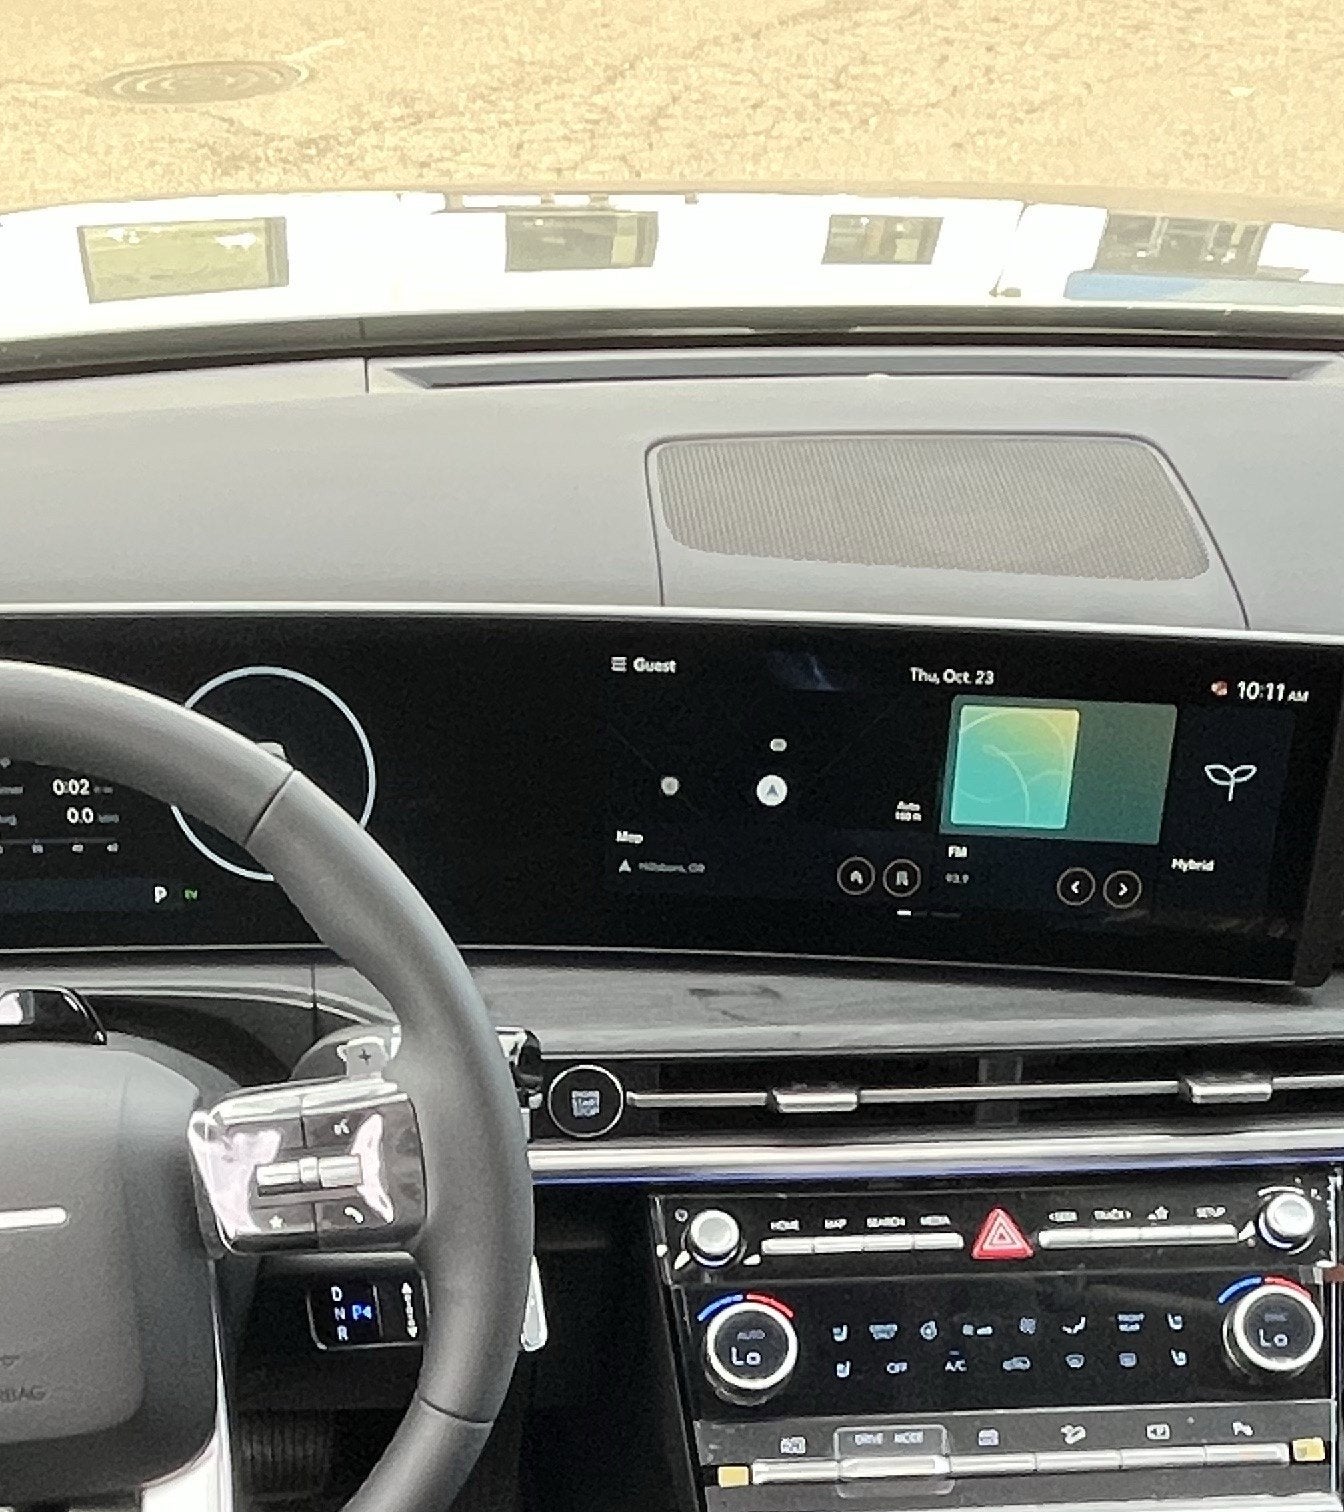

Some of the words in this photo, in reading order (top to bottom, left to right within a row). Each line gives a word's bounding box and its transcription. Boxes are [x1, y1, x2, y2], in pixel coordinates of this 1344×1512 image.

[633, 656, 677, 673] Guest
[909, 666, 940, 685] Thu,
[975, 670, 994, 685] 23
[1237, 680, 1286, 702] 10:11
[1287, 690, 1310, 702] AM
[52, 778, 90, 796] 0:02
[66, 806, 94, 824] 0.0
[615, 830, 644, 844] Map
[948, 845, 968, 858] FM
[1170, 858, 1216, 873] Hybrid
[154, 886, 168, 904] P
[824, 1218, 847, 1230] MAP
[866, 1216, 906, 1228] SEARCH
[330, 1285, 343, 1302] D
[334, 1306, 346, 1321] N
[351, 1304, 363, 1321] P
[336, 1325, 349, 1341] R
[1259, 1328, 1289, 1348] Lo
[730, 1346, 761, 1366] Lo
[944, 1359, 968, 1373] A/C
